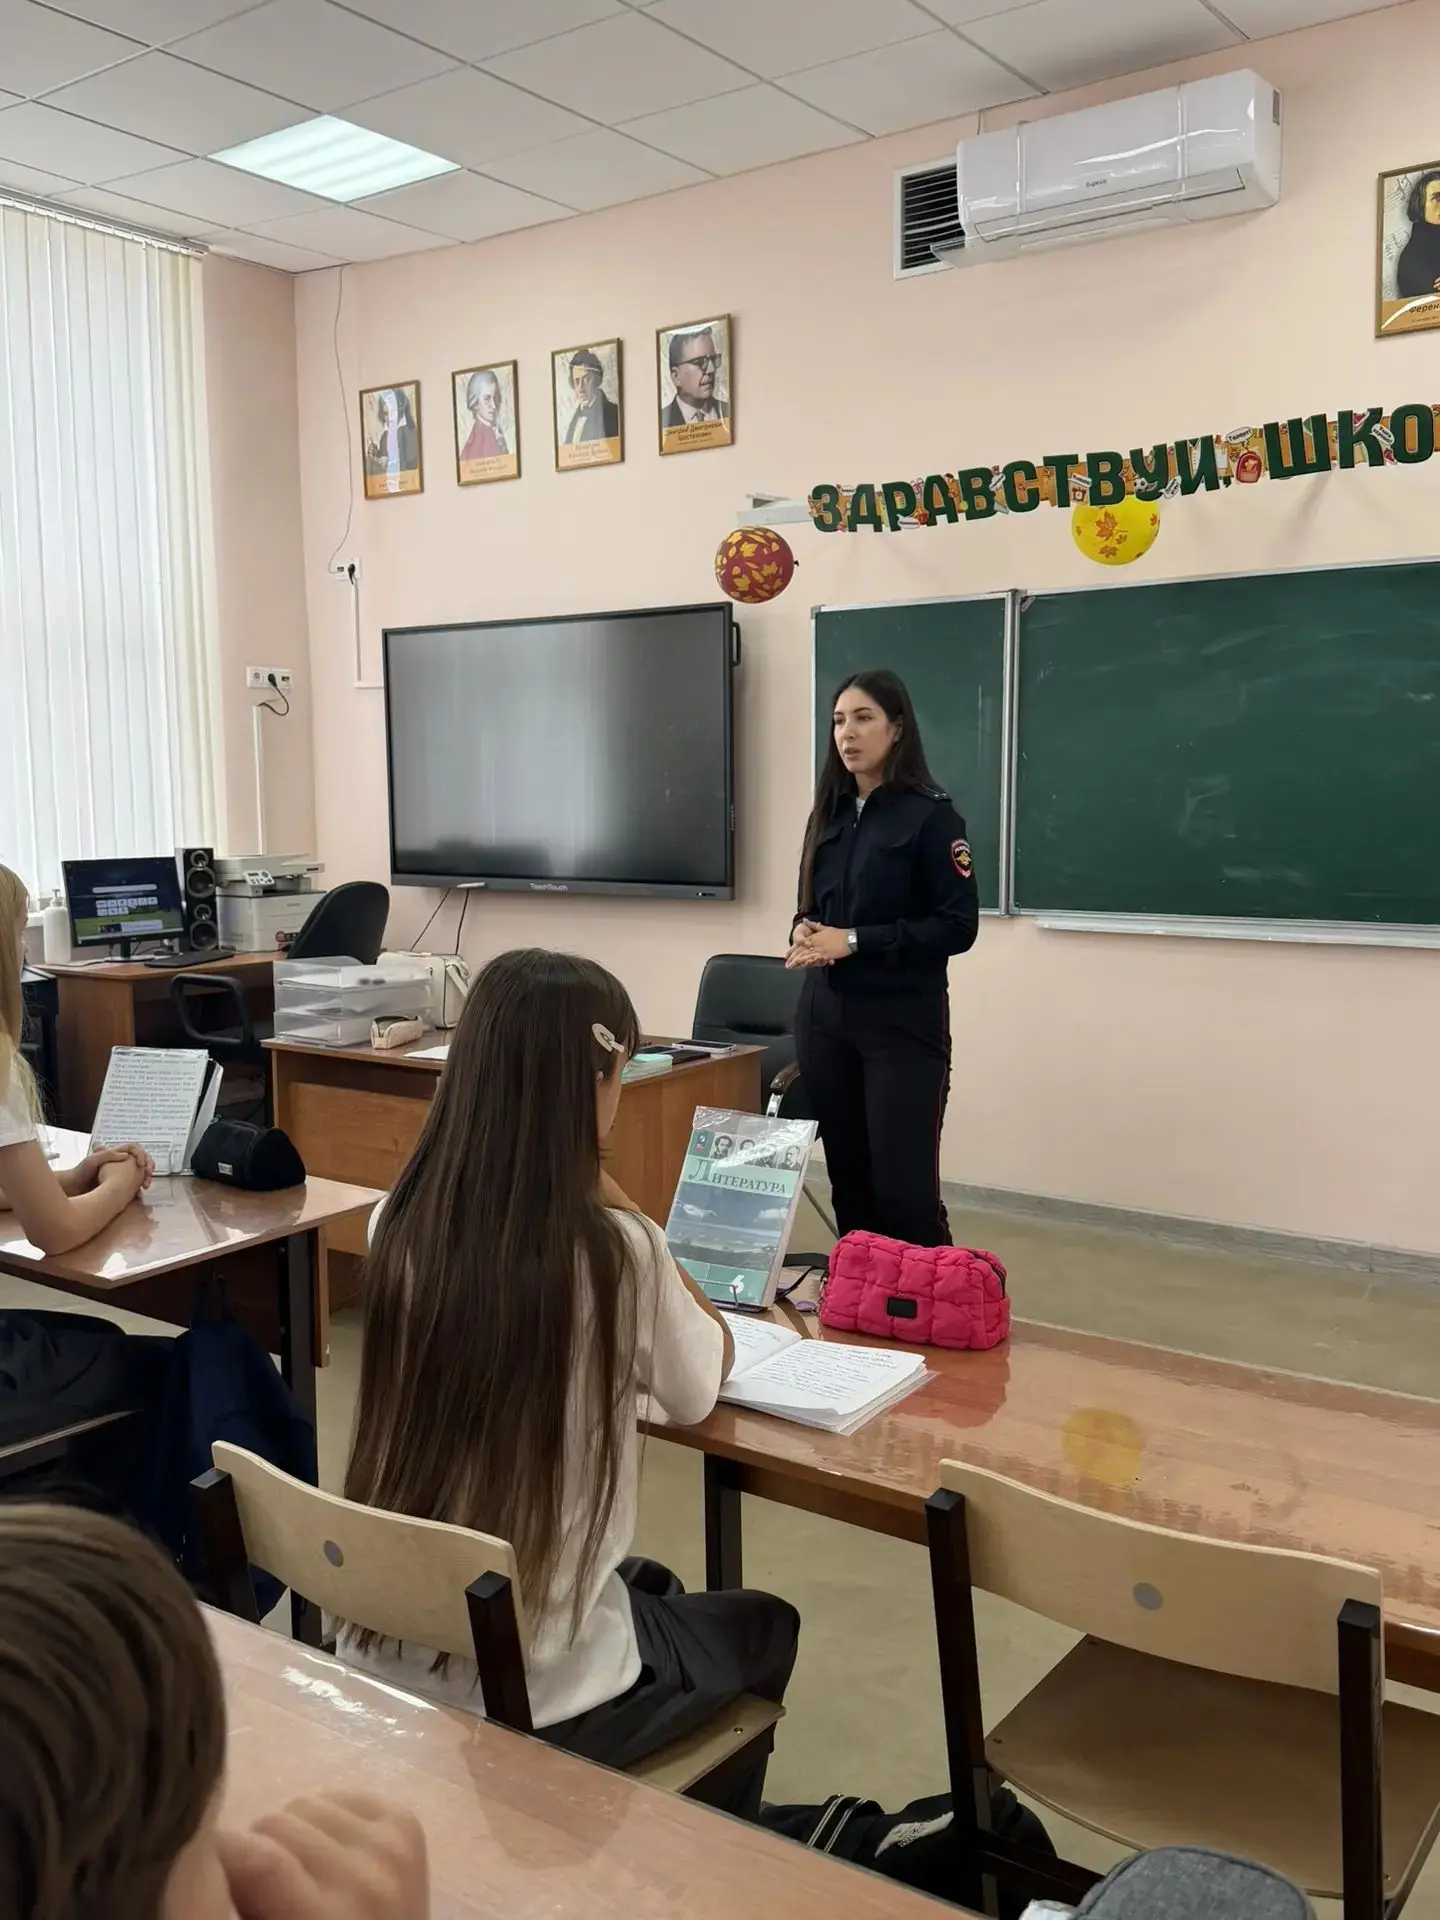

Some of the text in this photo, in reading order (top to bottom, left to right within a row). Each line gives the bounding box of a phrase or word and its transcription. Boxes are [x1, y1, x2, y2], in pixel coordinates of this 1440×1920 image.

[1409, 303, 1440, 313] Ферен
[1263, 403, 1435, 480] ШКО
[688, 1159, 785, 1193] ЛИТЕРАТУРА
[729, 1274, 745, 1294] 6
